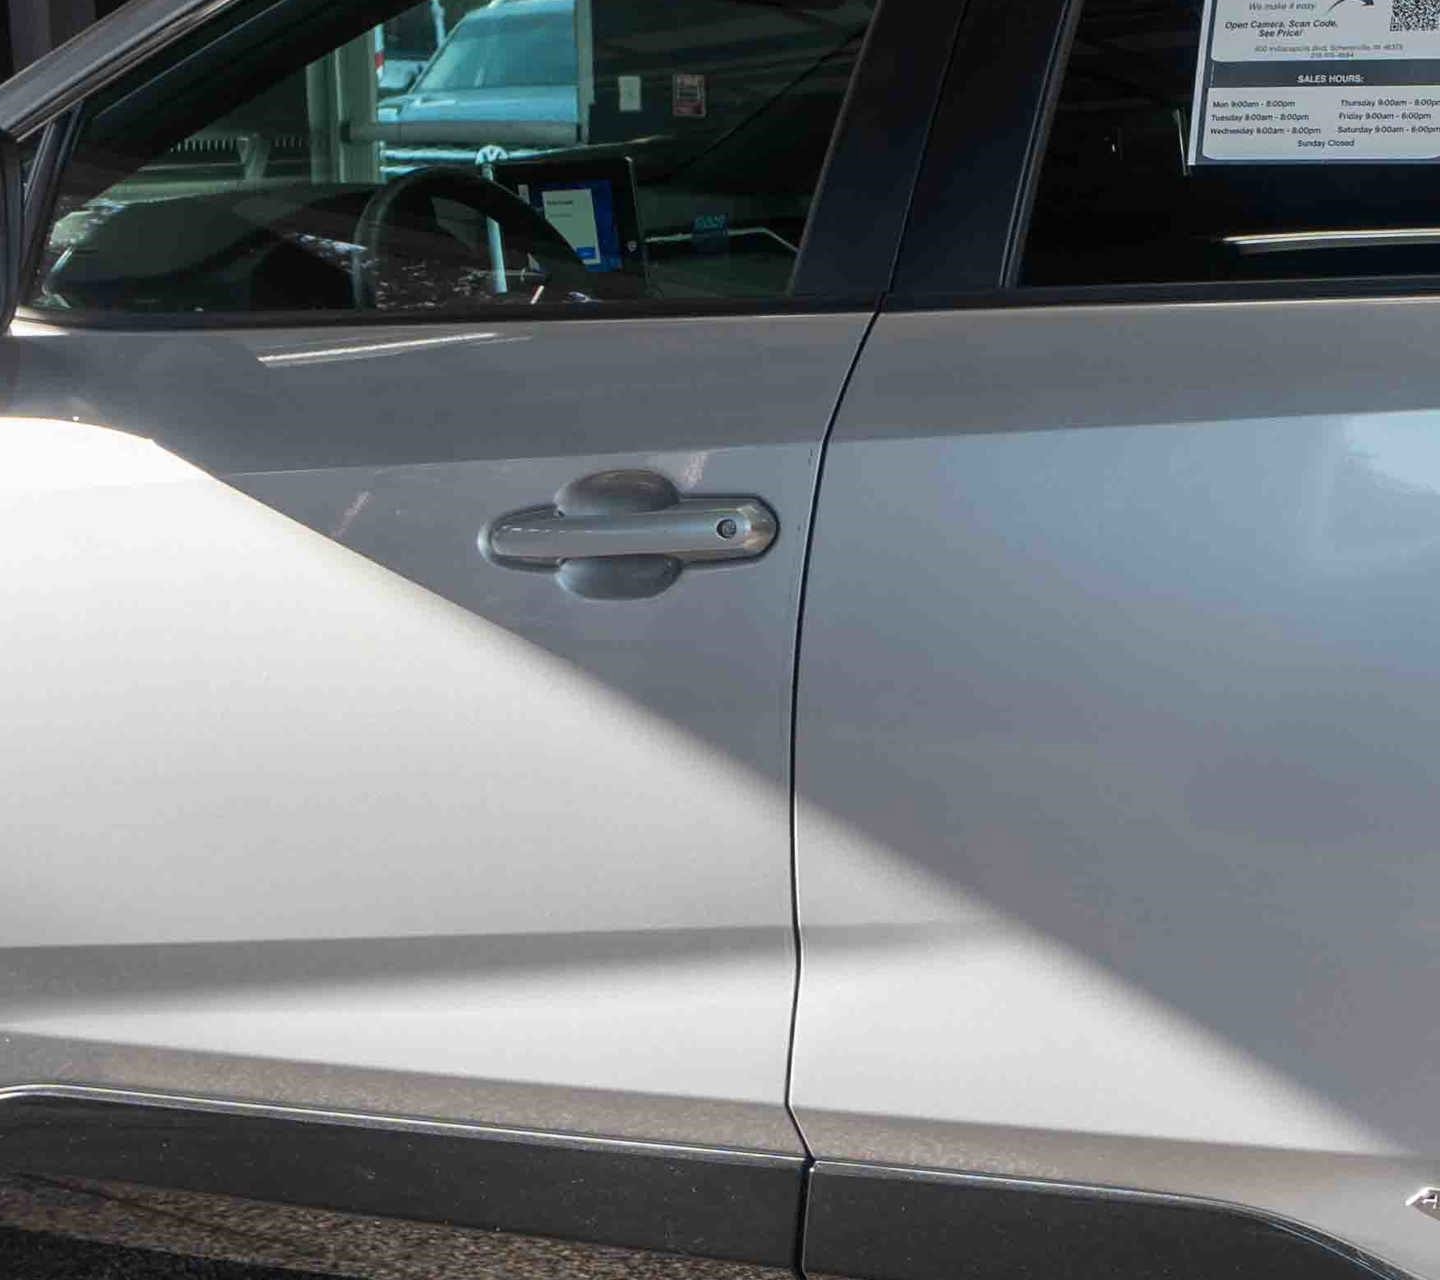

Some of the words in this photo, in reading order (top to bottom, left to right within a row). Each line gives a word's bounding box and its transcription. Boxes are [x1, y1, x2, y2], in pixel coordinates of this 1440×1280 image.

[1249, 2, 1262, 10] We
[1264, 2, 1288, 10] make
[1224, 21, 1249, 30] Open
[1289, 20, 1312, 28] Scan
[1258, 29, 1276, 38] See
[1277, 29, 1303, 38] Price!
[1296, 75, 1327, 83] SALES
[1328, 74, 1364, 83] HOURS:
[1340, 99, 1376, 108] Thursday
[1211, 114, 1243, 122] Tuesday
[1338, 112, 1364, 121] Friday
[1210, 127, 1254, 136] Wednesday
[1337, 126, 1373, 134] Saturday
[1297, 139, 1326, 148] Sunday
[1327, 139, 1355, 147] Closed
